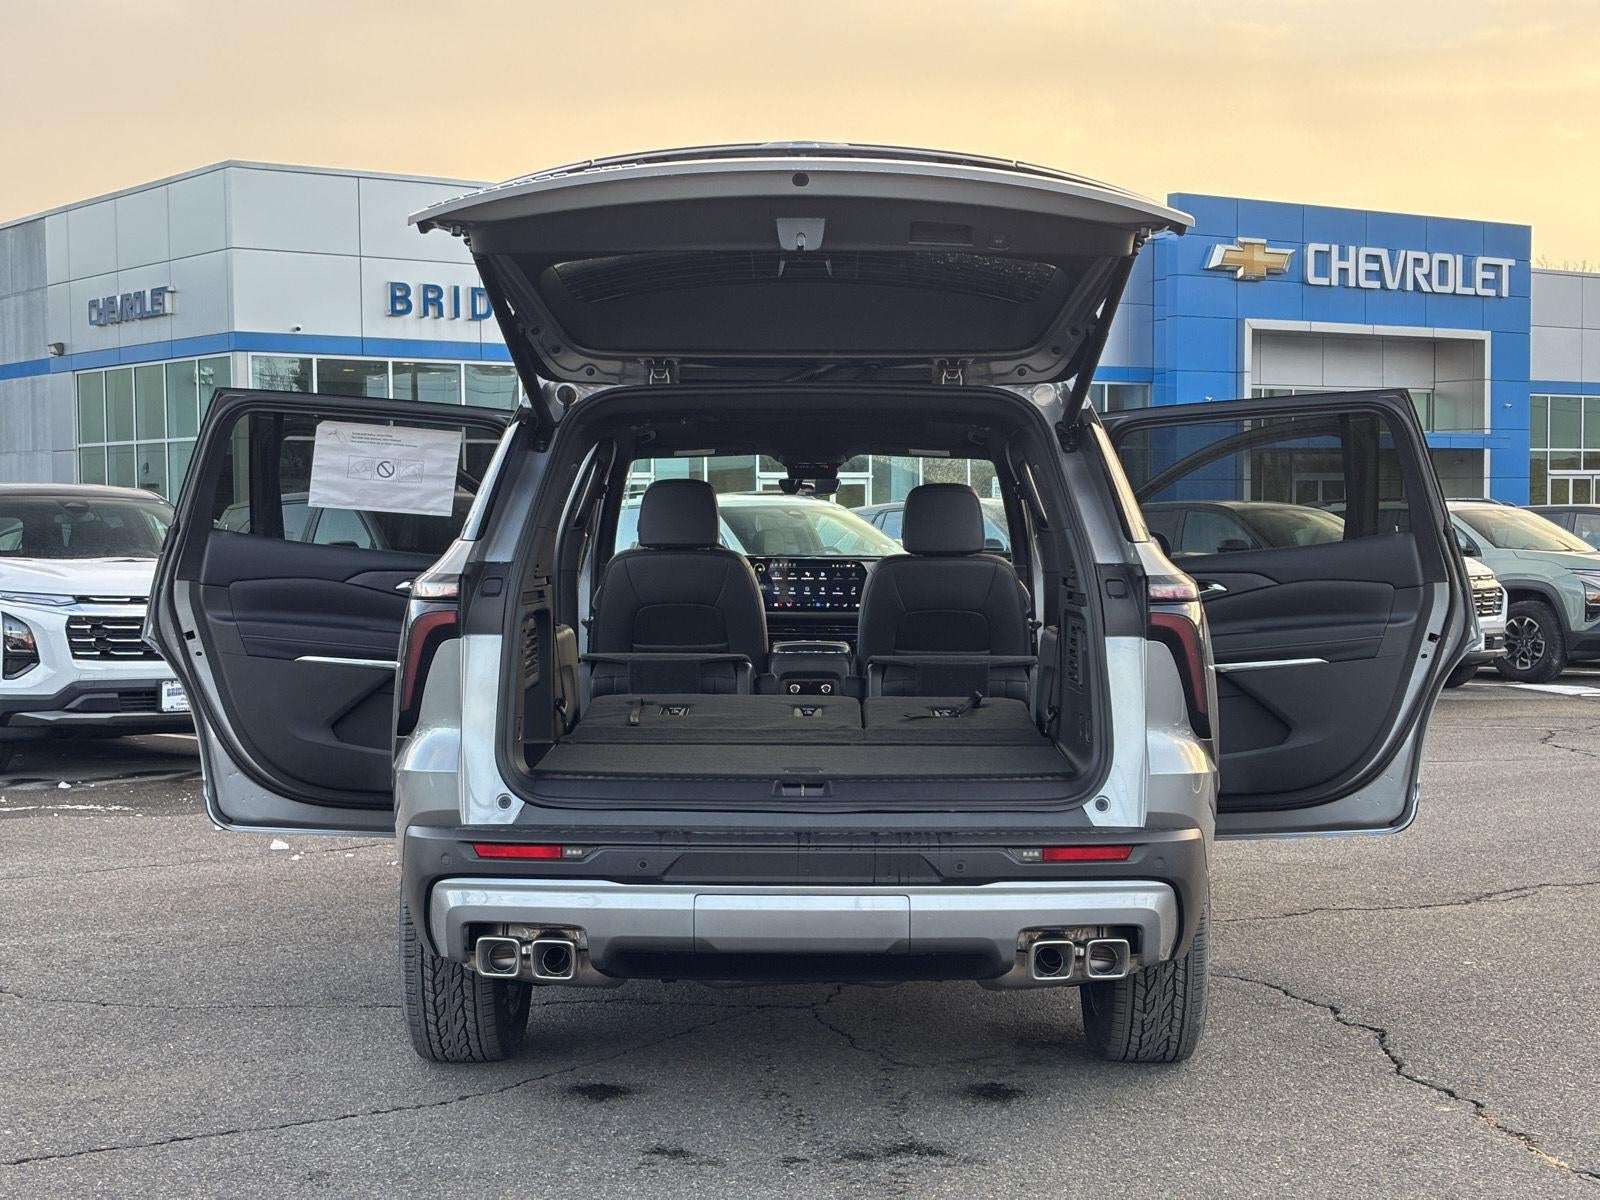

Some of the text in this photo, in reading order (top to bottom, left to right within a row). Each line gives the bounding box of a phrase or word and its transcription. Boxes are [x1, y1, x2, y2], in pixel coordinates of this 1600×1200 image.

[1306, 242, 1516, 298] CHEVROLET
[88, 286, 172, 326] CHEVROLET
[387, 281, 493, 321] BRID
